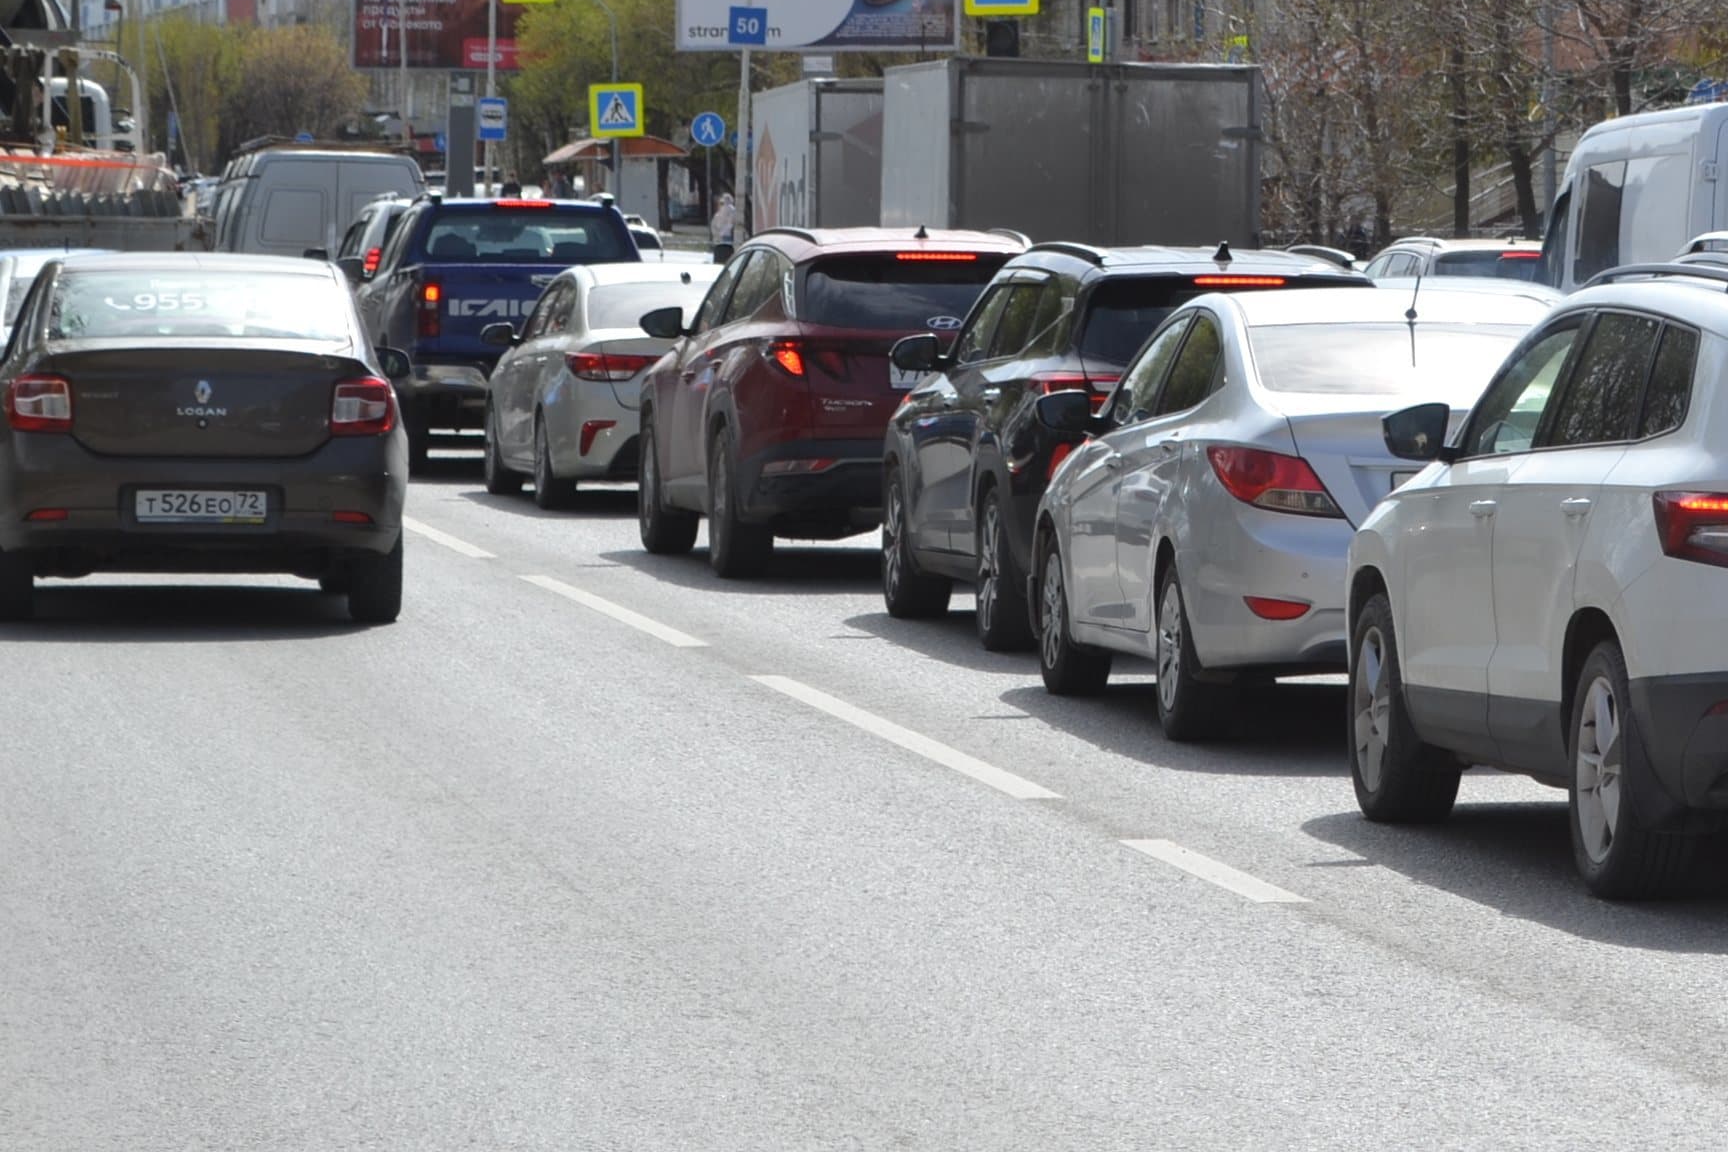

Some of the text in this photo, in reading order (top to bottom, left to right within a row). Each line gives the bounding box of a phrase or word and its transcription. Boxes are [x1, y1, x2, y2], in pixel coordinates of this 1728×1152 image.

[736, 17, 760, 35] 50
[176, 407, 227, 416] LOGAN
[238, 493, 259, 509] 72
